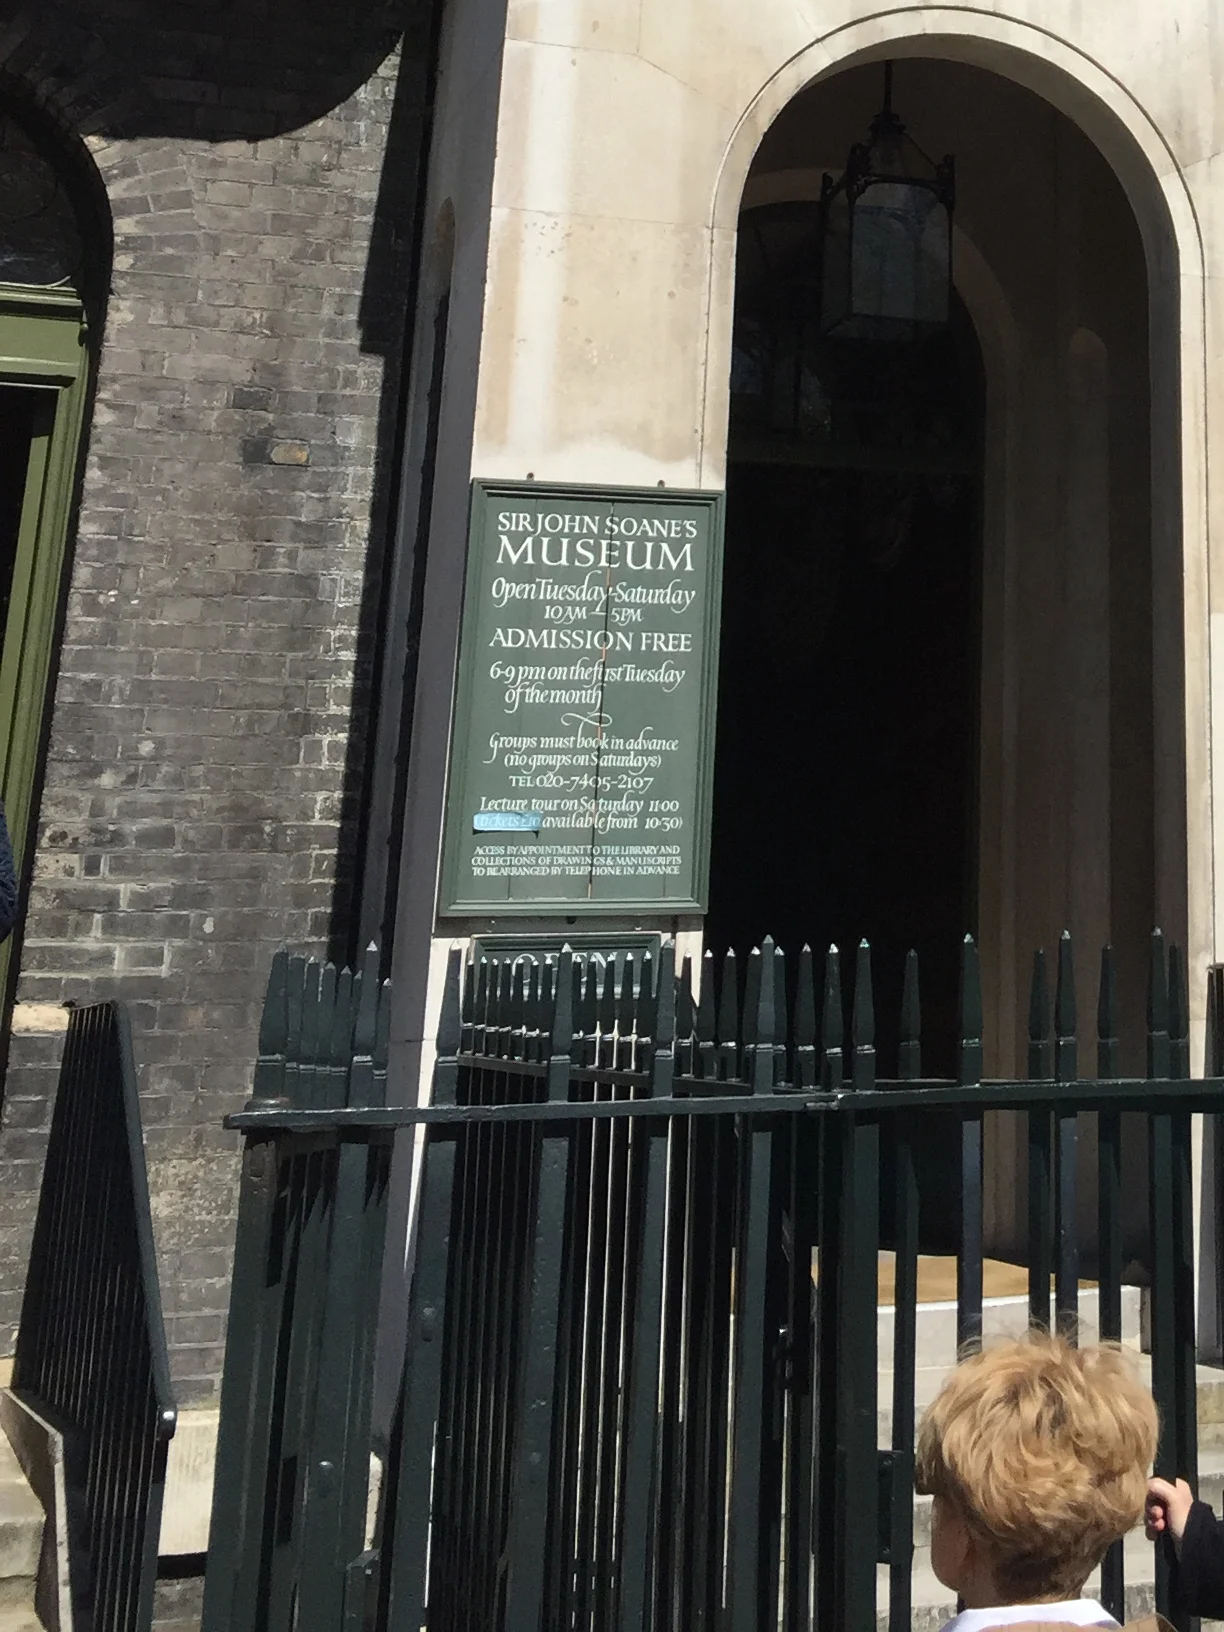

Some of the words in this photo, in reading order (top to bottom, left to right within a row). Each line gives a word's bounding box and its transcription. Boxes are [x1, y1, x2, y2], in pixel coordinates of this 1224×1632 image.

[498, 512, 533, 532] SIR
[532, 513, 600, 538] JOHN
[496, 534, 695, 571] MUSEUM
[491, 577, 536, 608] Open
[489, 628, 635, 652] ADMISSION
[641, 632, 692, 653] FREE
[547, 666, 568, 680] on
[569, 657, 593, 680] the
[582, 658, 624, 688] first
[622, 659, 686, 693] Tuesday
[504, 681, 530, 713] of
[524, 681, 549, 703] the
[549, 683, 604, 715] month
[483, 732, 538, 763] Groups
[540, 735, 576, 748] must
[611, 735, 625, 750] in
[625, 726, 680, 751] advance
[504, 753, 527, 767] (no
[521, 754, 572, 774] groups
[572, 754, 589, 766] on
[590, 751, 662, 776] Saturdays)
[480, 796, 528, 811] Lecture
[531, 798, 560, 813] tour
[560, 799, 579, 811] on
[580, 790, 644, 817] Saturday
[542, 808, 605, 828] available
[598, 810, 638, 835] from
[471, 856, 536, 866] COLLECTIONS
[538, 856, 552, 866] OF
[553, 856, 606, 866] DRAWINGS
[606, 856, 615, 866] &
[616, 856, 682, 865] MANUSCRIPTS
[474, 845, 505, 855] ACCESS
[506, 845, 518, 855] BY
[517, 845, 585, 855] APPOINTMENT
[584, 845, 600, 856] TO
[601, 845, 620, 855] THE
[620, 845, 659, 855] LIBRARY
[658, 845, 681, 855] AND
[472, 867, 486, 876] TO
[486, 867, 498, 876] BE
[498, 867, 550, 876] ARRANGED
[551, 867, 563, 876] BY
[565, 866, 621, 876] TELEPHONE
[623, 866, 635, 875] IN
[636, 866, 680, 875] ADVANCE
